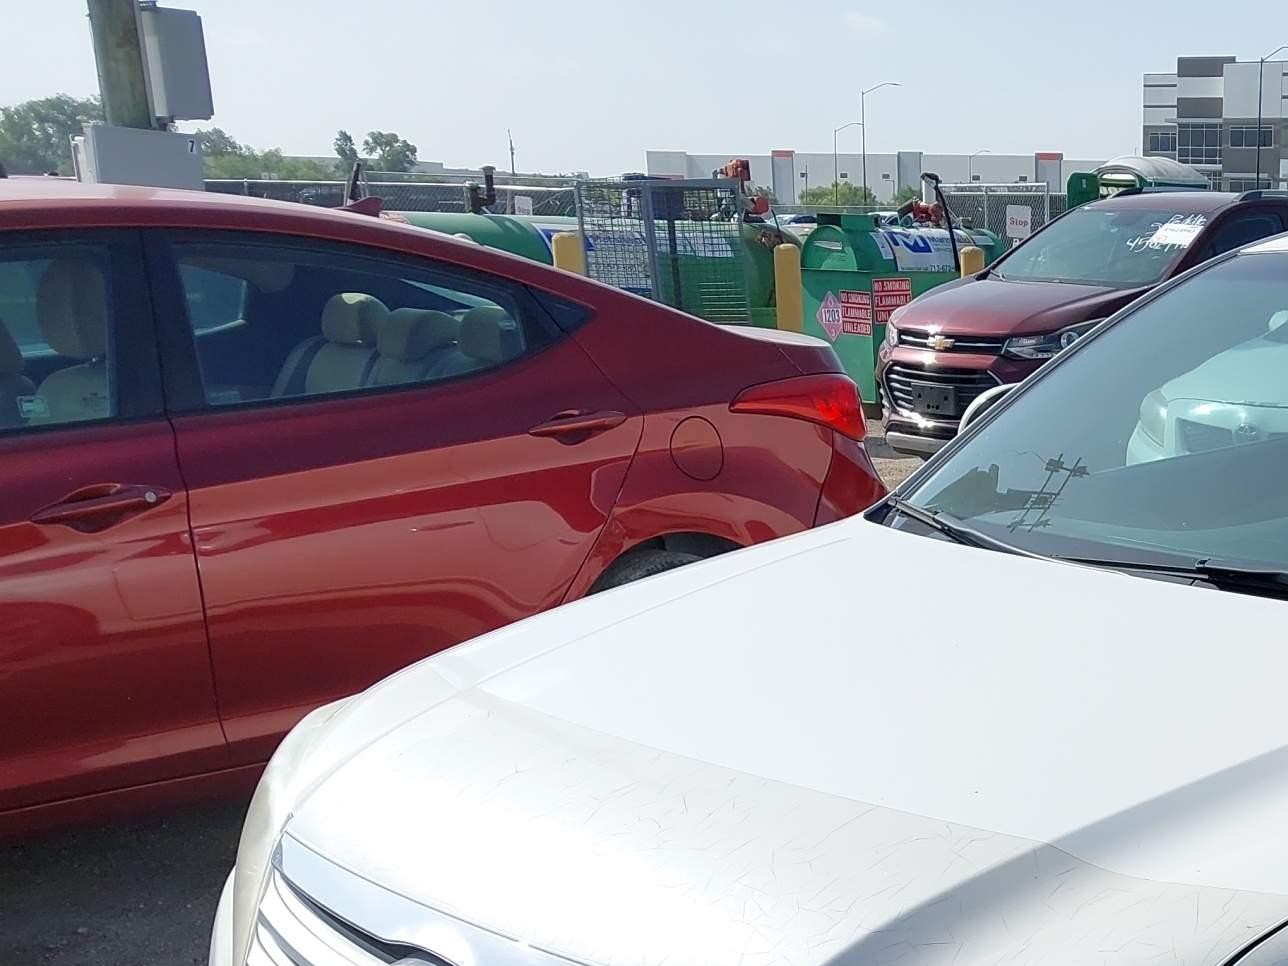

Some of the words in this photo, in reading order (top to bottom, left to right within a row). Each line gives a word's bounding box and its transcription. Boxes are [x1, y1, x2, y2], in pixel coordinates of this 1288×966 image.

[188, 140, 195, 153] 7
[1009, 216, 1029, 228] Stop
[884, 280, 910, 291] SMOKING
[875, 296, 910, 306] FLAMMABLE
[824, 309, 840, 323] 1203
[843, 306, 871, 319] FLAMMABLE
[843, 322, 871, 335] UNLEADED
